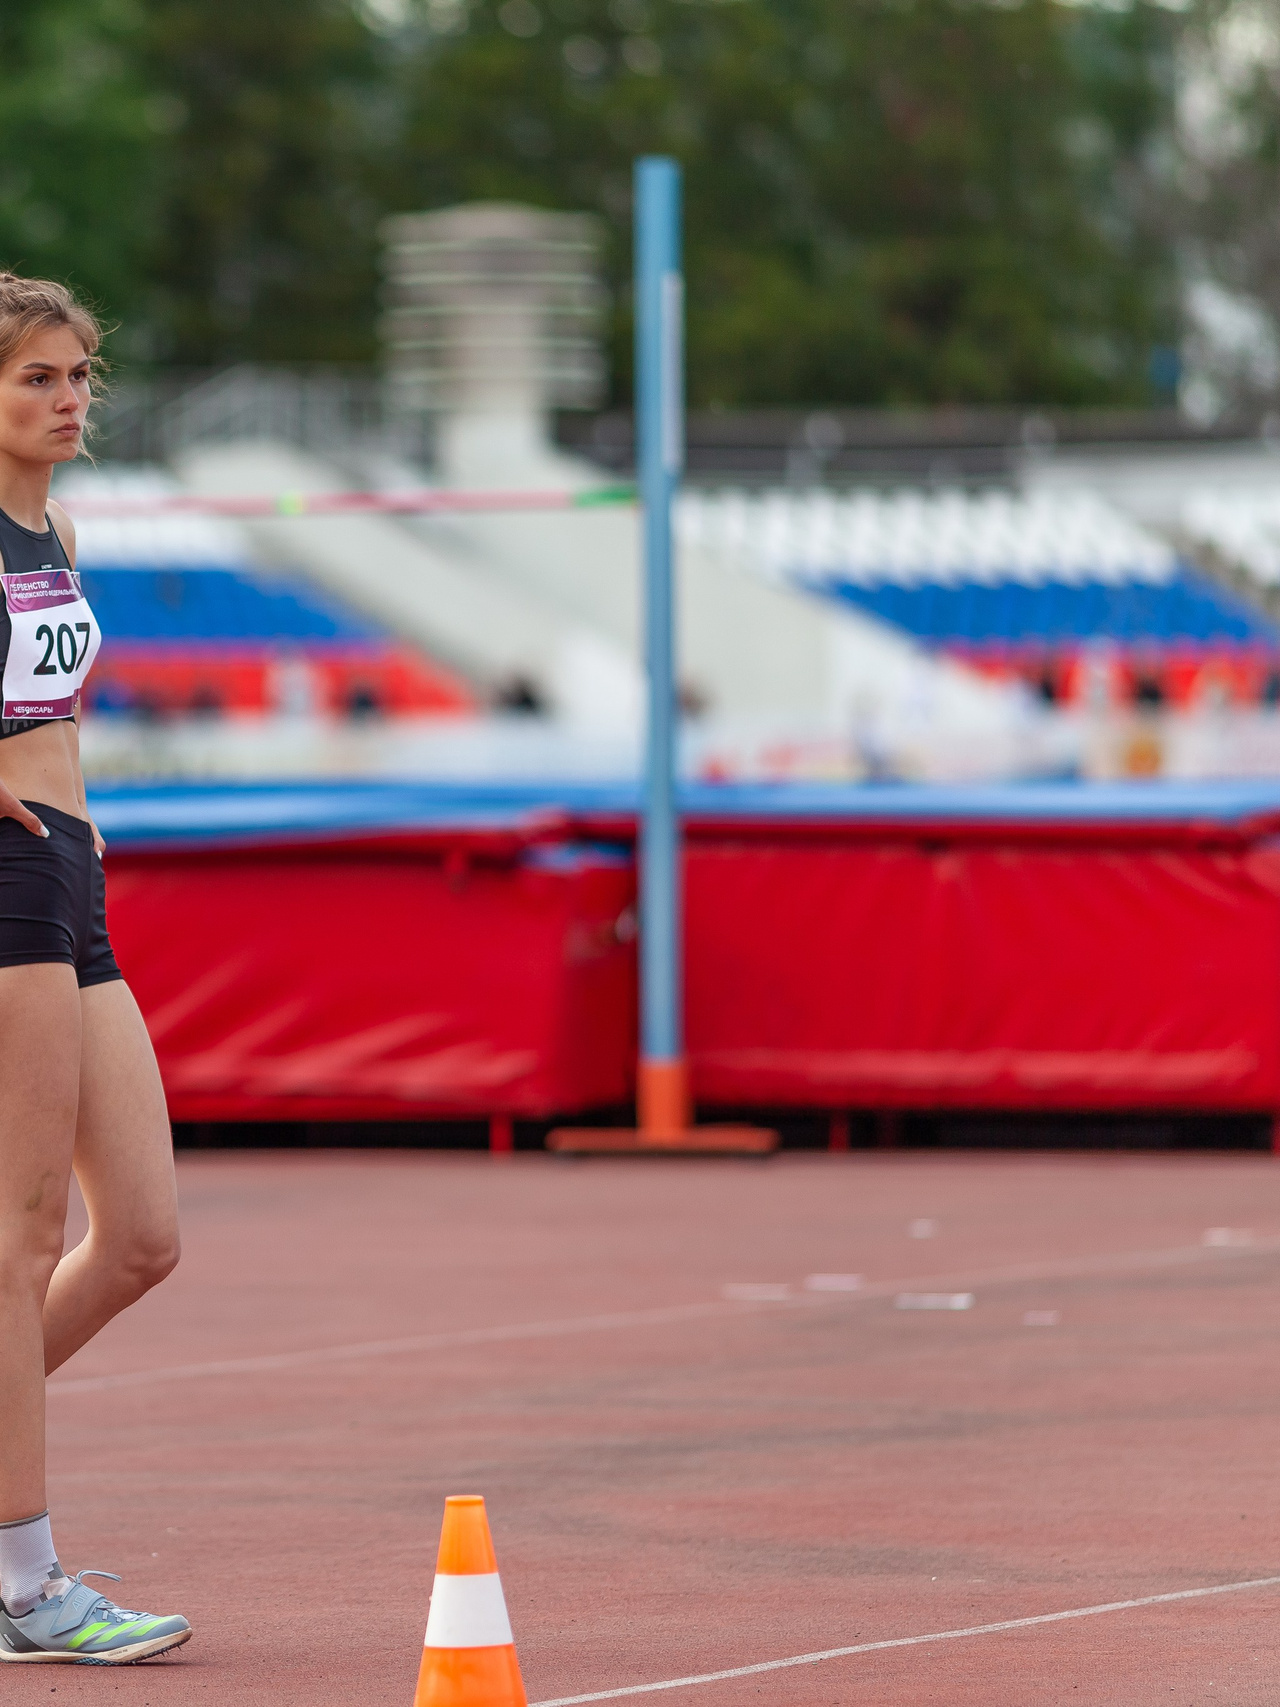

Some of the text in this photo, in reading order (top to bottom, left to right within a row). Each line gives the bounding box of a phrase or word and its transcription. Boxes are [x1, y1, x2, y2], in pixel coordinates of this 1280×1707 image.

[9, 580, 50, 592] ПЕРВЕНСТВО
[33, 622, 90, 675] 207
[13, 705, 54, 714] ЧЕБОКСАРЫ
